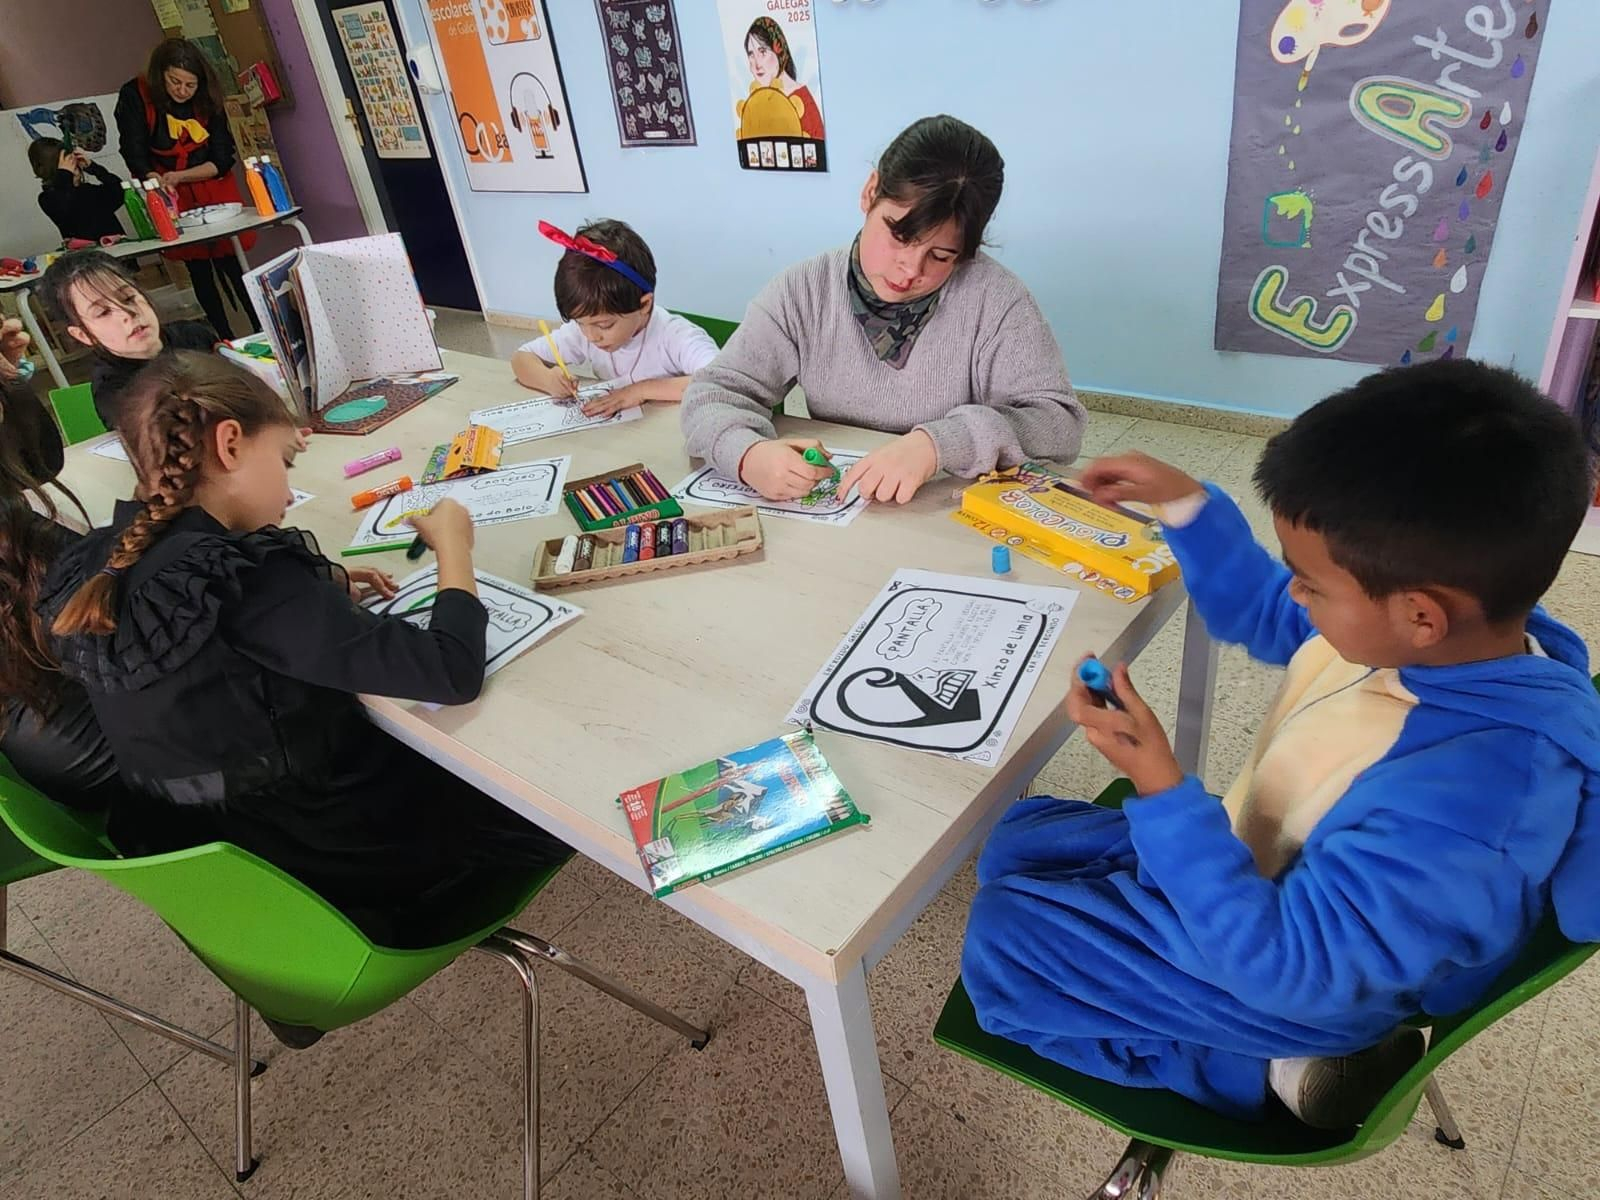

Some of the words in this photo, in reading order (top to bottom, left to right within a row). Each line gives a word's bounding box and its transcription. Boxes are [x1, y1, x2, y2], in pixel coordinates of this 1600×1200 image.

[431, 2, 474, 21] escolares
[767, 0, 809, 10] GALEGAS
[788, 10, 810, 22] 2025
[888, 604, 930, 652] PANTALLA
[1007, 614, 1034, 640] Limia
[1000, 642, 1018, 655] de
[982, 658, 1009, 688] Xinzo
